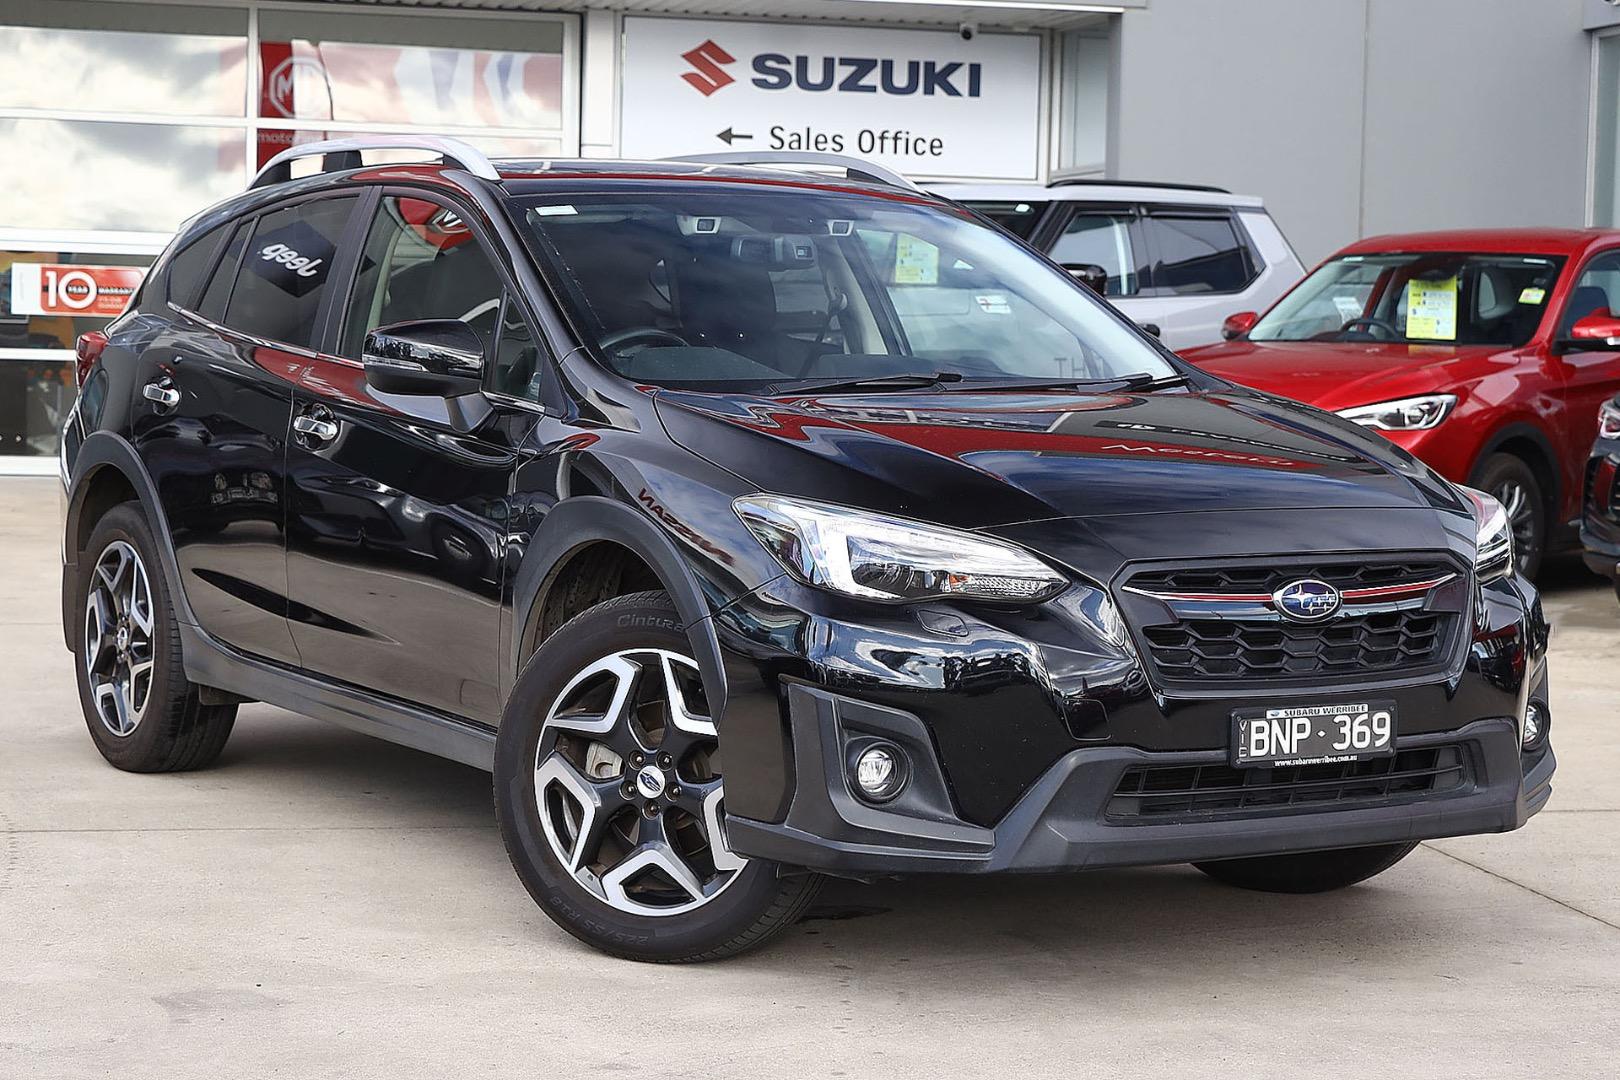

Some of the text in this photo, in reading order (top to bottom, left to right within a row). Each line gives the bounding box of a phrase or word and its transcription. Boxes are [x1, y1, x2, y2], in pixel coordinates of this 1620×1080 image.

[751, 53, 982, 98] SUZUKI
[769, 125, 944, 156] Sales Office
[45, 270, 97, 309] 10
[1284, 704, 1367, 717] SUBARU WERRIBEE
[1250, 711, 1391, 757] BNP 369
